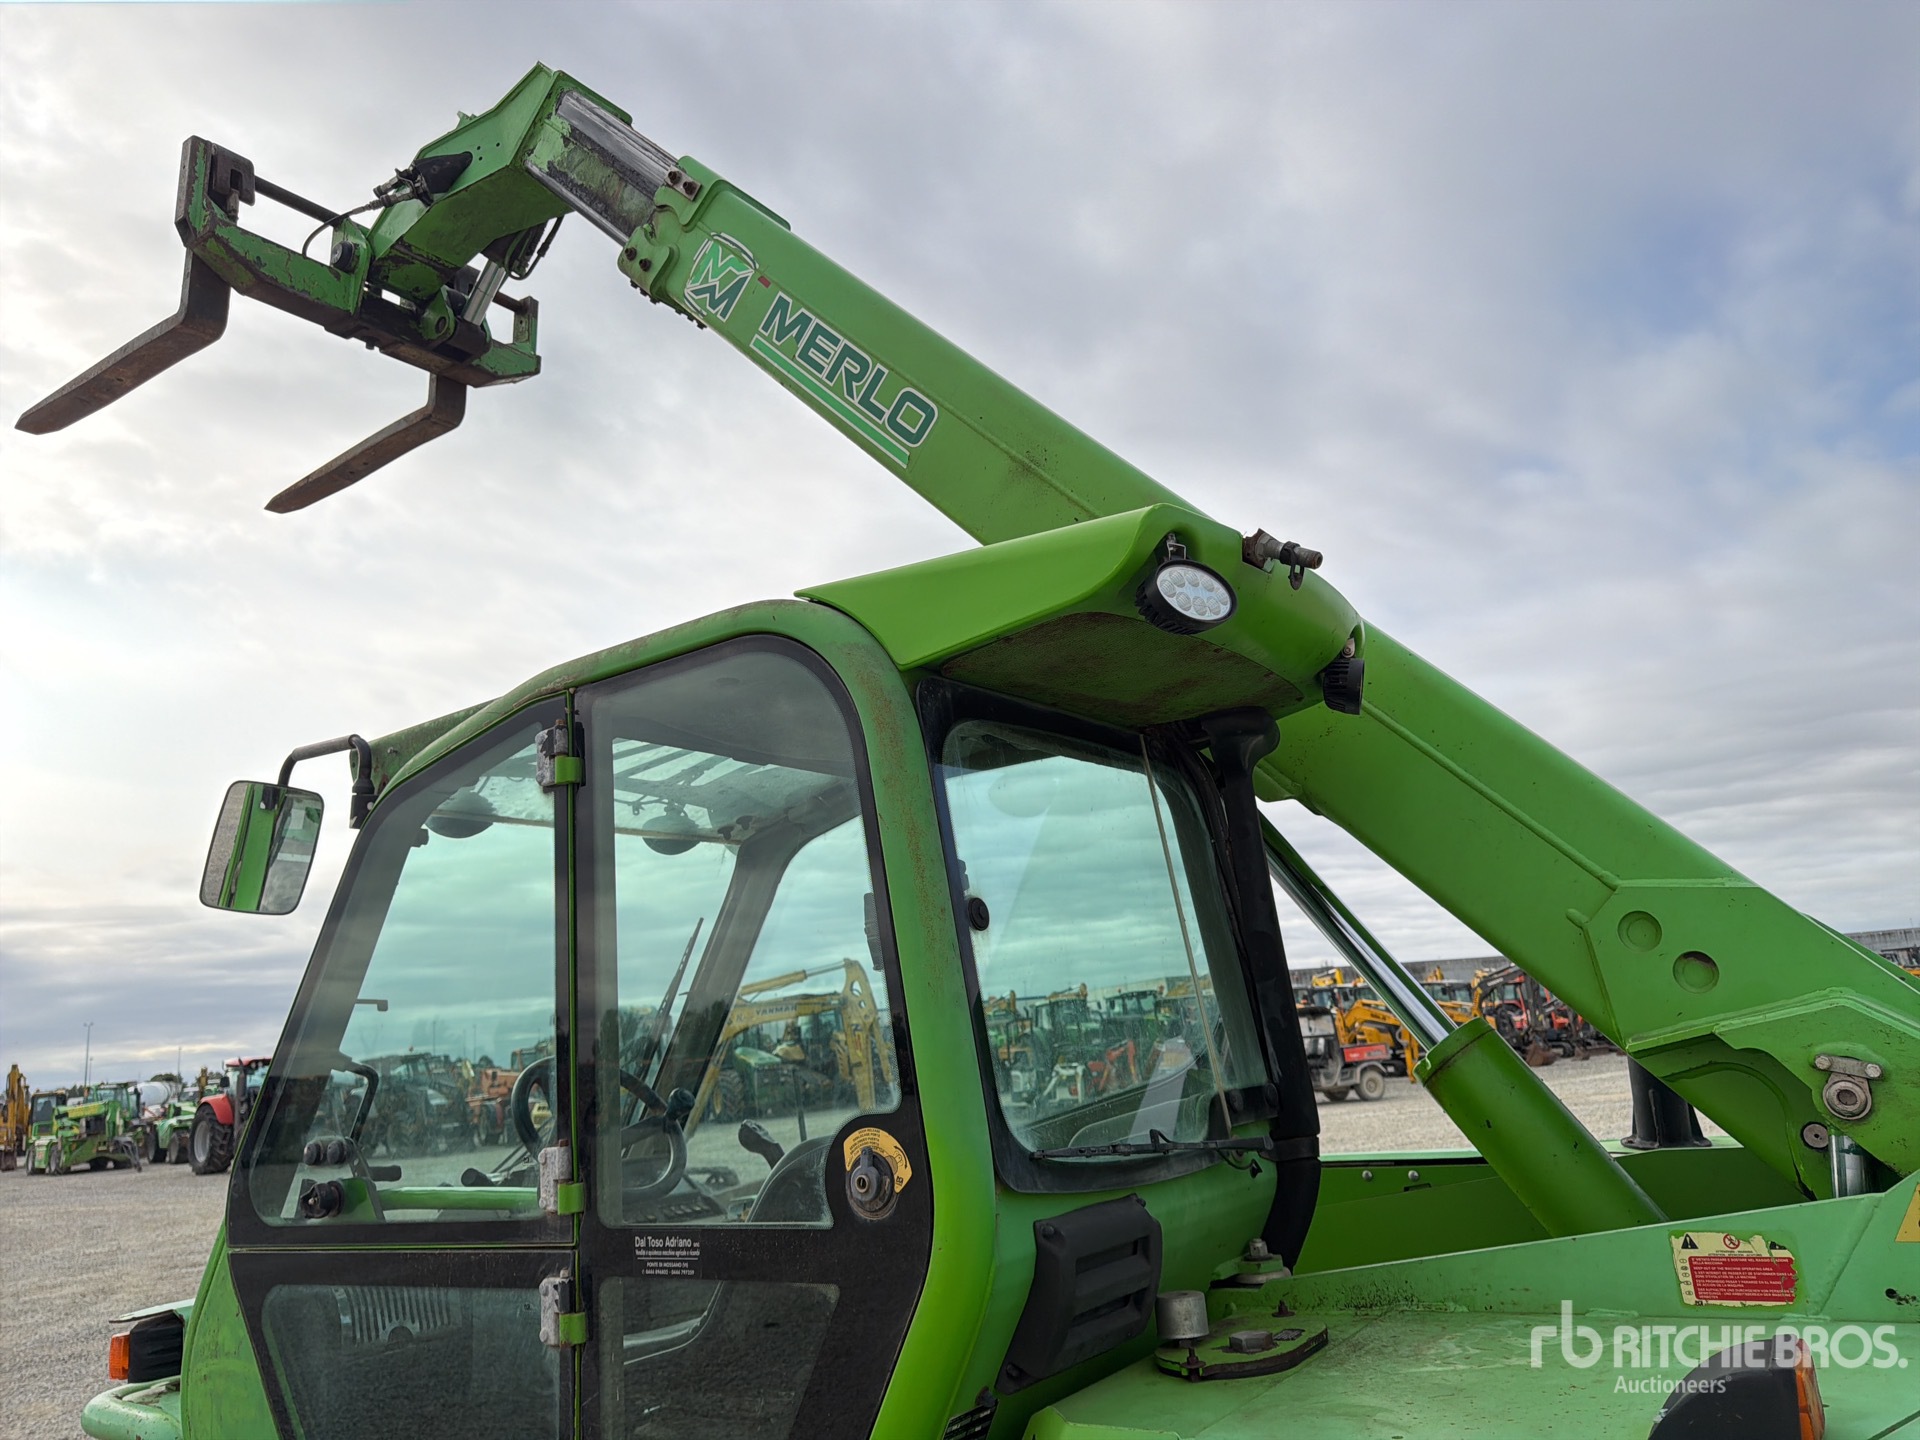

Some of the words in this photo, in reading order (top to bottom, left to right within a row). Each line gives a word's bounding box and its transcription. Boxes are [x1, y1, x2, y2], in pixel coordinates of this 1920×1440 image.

[759, 291, 938, 447] MERLO
[635, 1236, 646, 1247] Dal
[647, 1236, 664, 1247] Toso
[665, 1236, 692, 1247] Adriano
